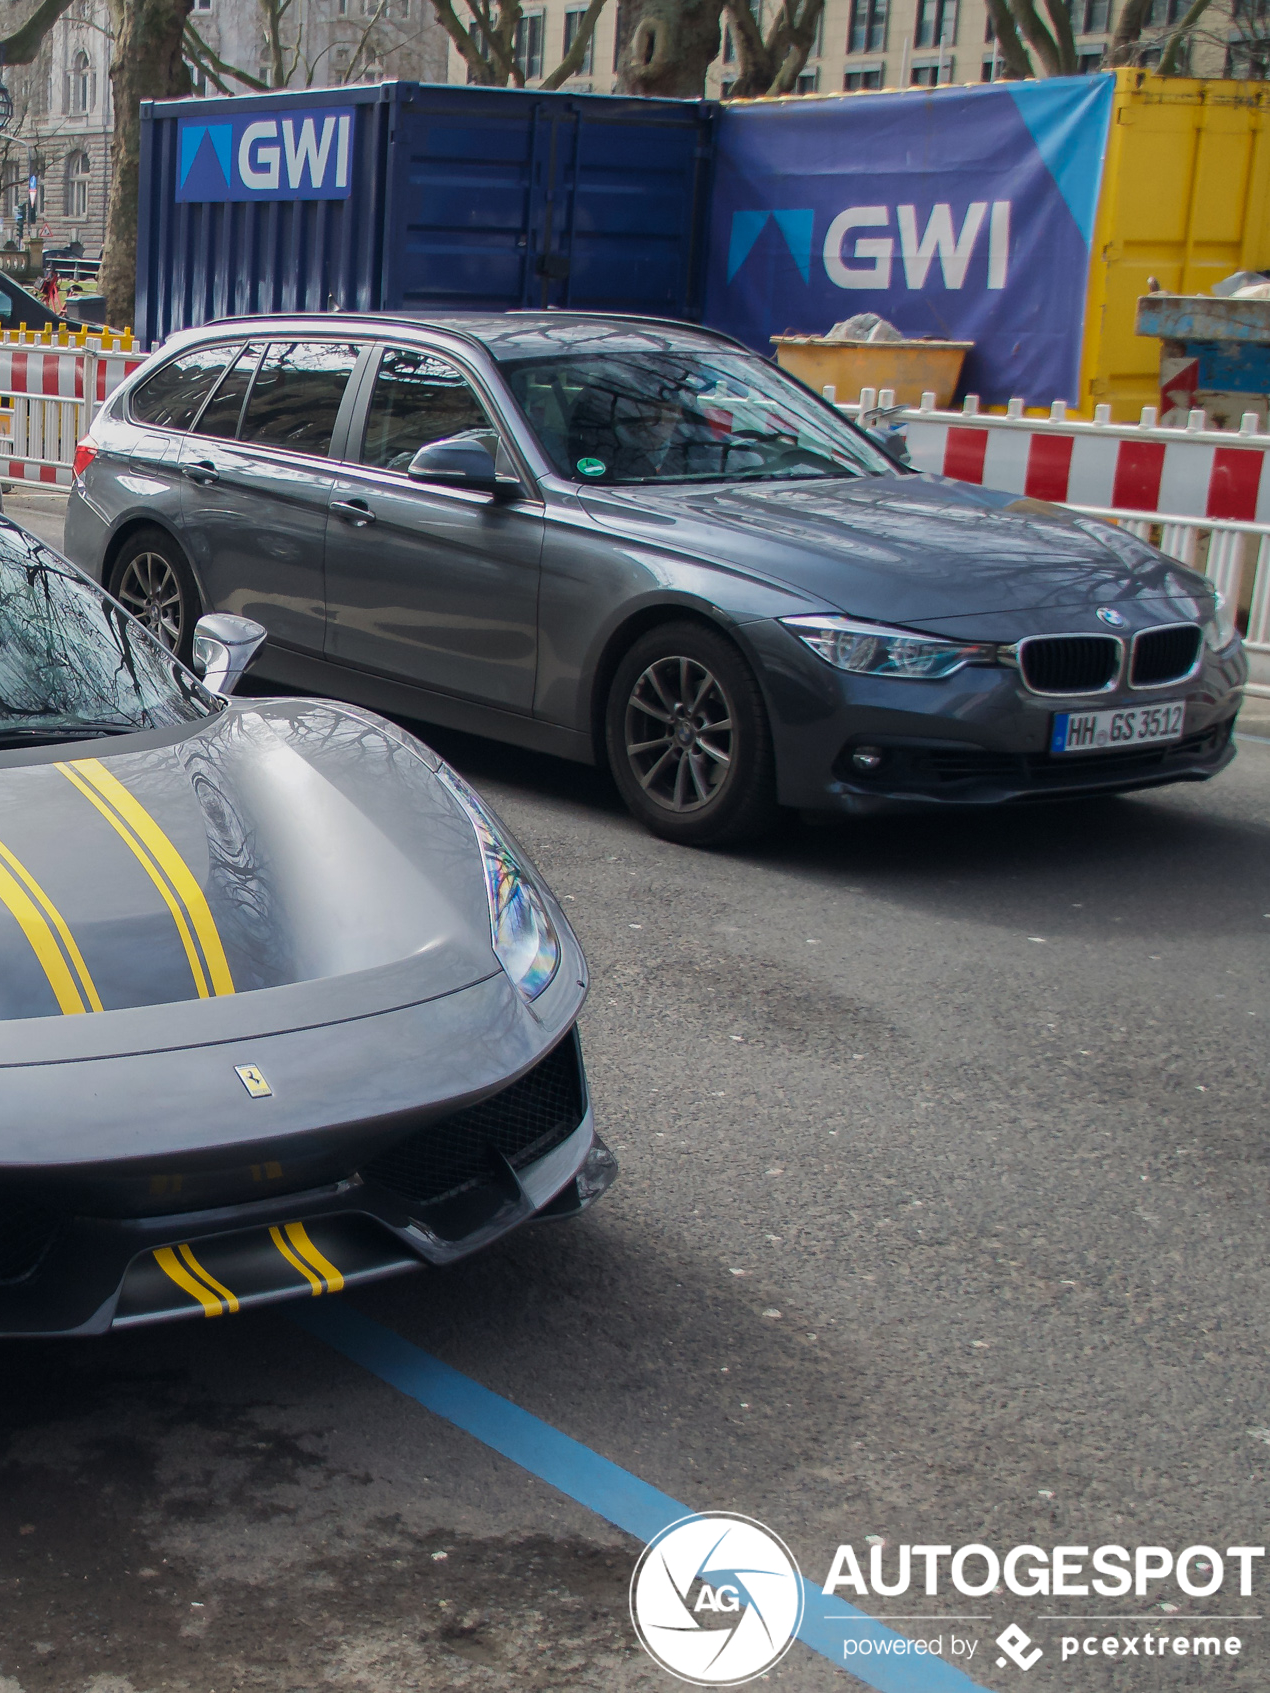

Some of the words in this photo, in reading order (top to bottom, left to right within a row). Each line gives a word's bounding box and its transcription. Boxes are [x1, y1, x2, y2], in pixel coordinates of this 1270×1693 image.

[238, 115, 350, 190] GWI
[823, 201, 1011, 289] GWI
[1066, 716, 1097, 746] HH
[1110, 712, 1135, 742] GS
[1137, 706, 1182, 739] 3512
